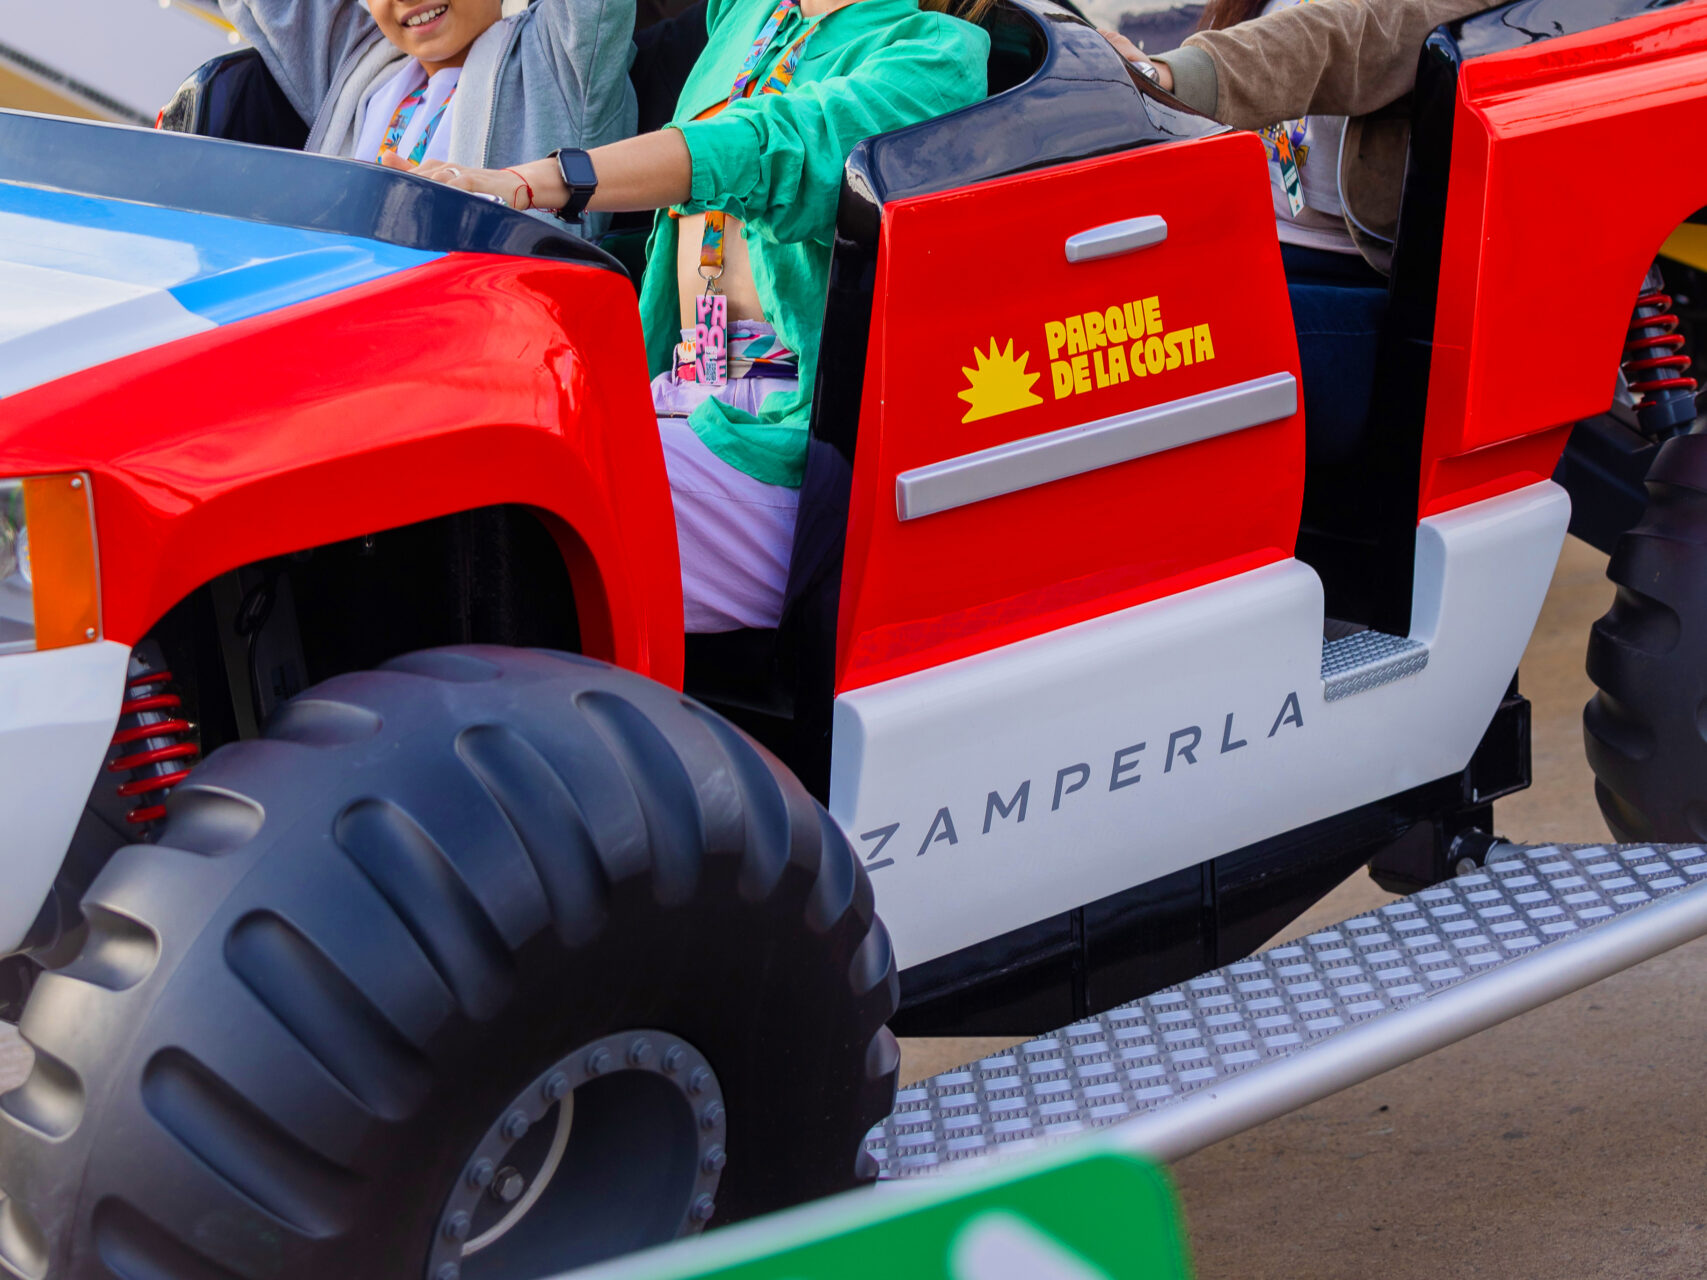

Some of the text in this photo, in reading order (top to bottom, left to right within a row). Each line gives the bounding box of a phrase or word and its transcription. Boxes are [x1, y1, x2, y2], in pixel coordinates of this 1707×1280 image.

[1044, 295, 1164, 360] PARQUE
[1050, 323, 1215, 400] DE LA COSTA
[860, 691, 1304, 872] ZAMPERLA
